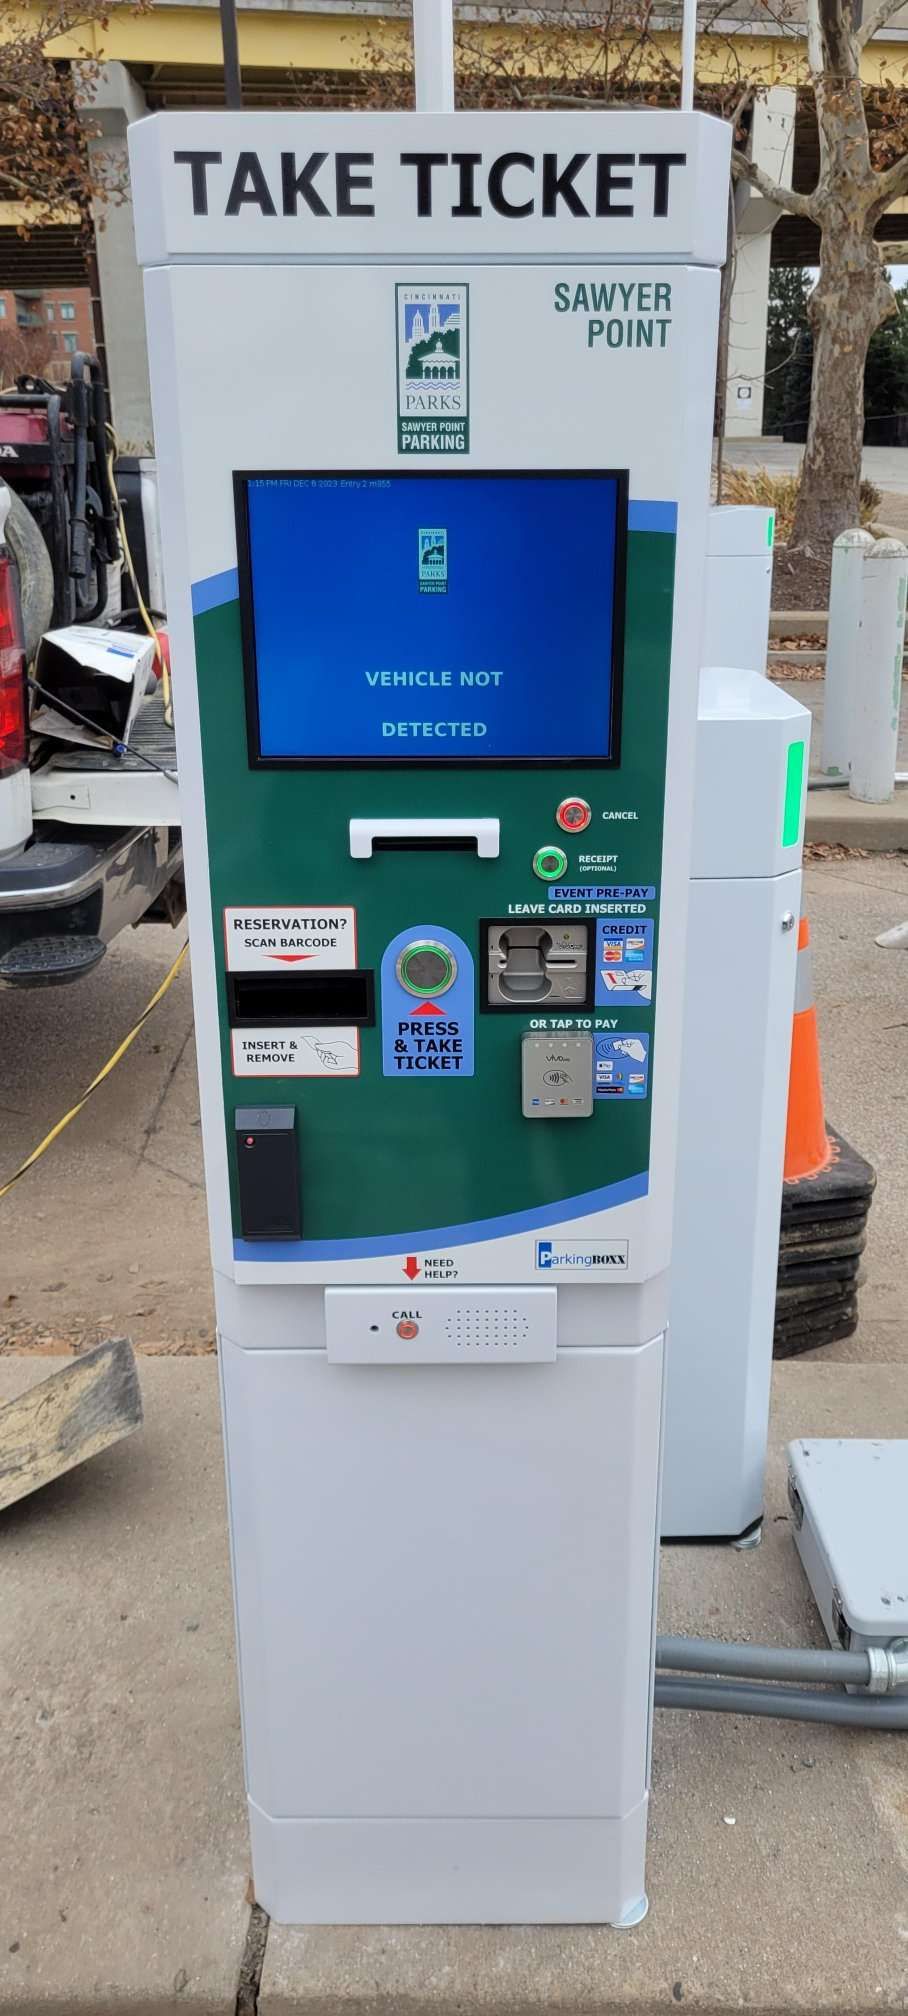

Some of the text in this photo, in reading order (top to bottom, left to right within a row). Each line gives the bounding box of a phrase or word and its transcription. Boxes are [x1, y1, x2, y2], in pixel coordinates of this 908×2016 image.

[173, 150, 688, 219] TAKE TICKET
[554, 282, 672, 312] SAWYER
[588, 318, 672, 348] POINT
[405, 395, 461, 410] PARKS
[401, 422, 465, 432] SAWYER POINT
[402, 434, 465, 450] PARKING
[266, 479, 278, 488] PM
[293, 479, 310, 488] DEC
[318, 479, 338, 488] 2023
[340, 479, 361, 489] Entry
[365, 671, 504, 687] VEHICLE NOT
[382, 722, 488, 737] DETECTED
[602, 811, 639, 820] CANCEL
[578, 855, 618, 863] RECEIPT
[554, 888, 649, 898] EVENT PRE-PAY
[508, 904, 647, 914] LEAVE CARD INSERTED
[233, 918, 348, 930] RESERVATION?
[602, 925, 648, 935] CREDIT
[244, 938, 337, 948] SCAN BARCODE
[398, 1021, 459, 1036] PRESS
[529, 1019, 618, 1029] OR TAP TO PAY
[242, 1041, 298, 1050] INSERT &
[394, 1038, 463, 1053] & TAKE
[246, 1053, 296, 1062] REMOVE
[393, 1056, 463, 1069] TICKET
[424, 1259, 454, 1267] NEED
[424, 1271, 459, 1279] HELP?
[391, 1311, 423, 1319] CALL
